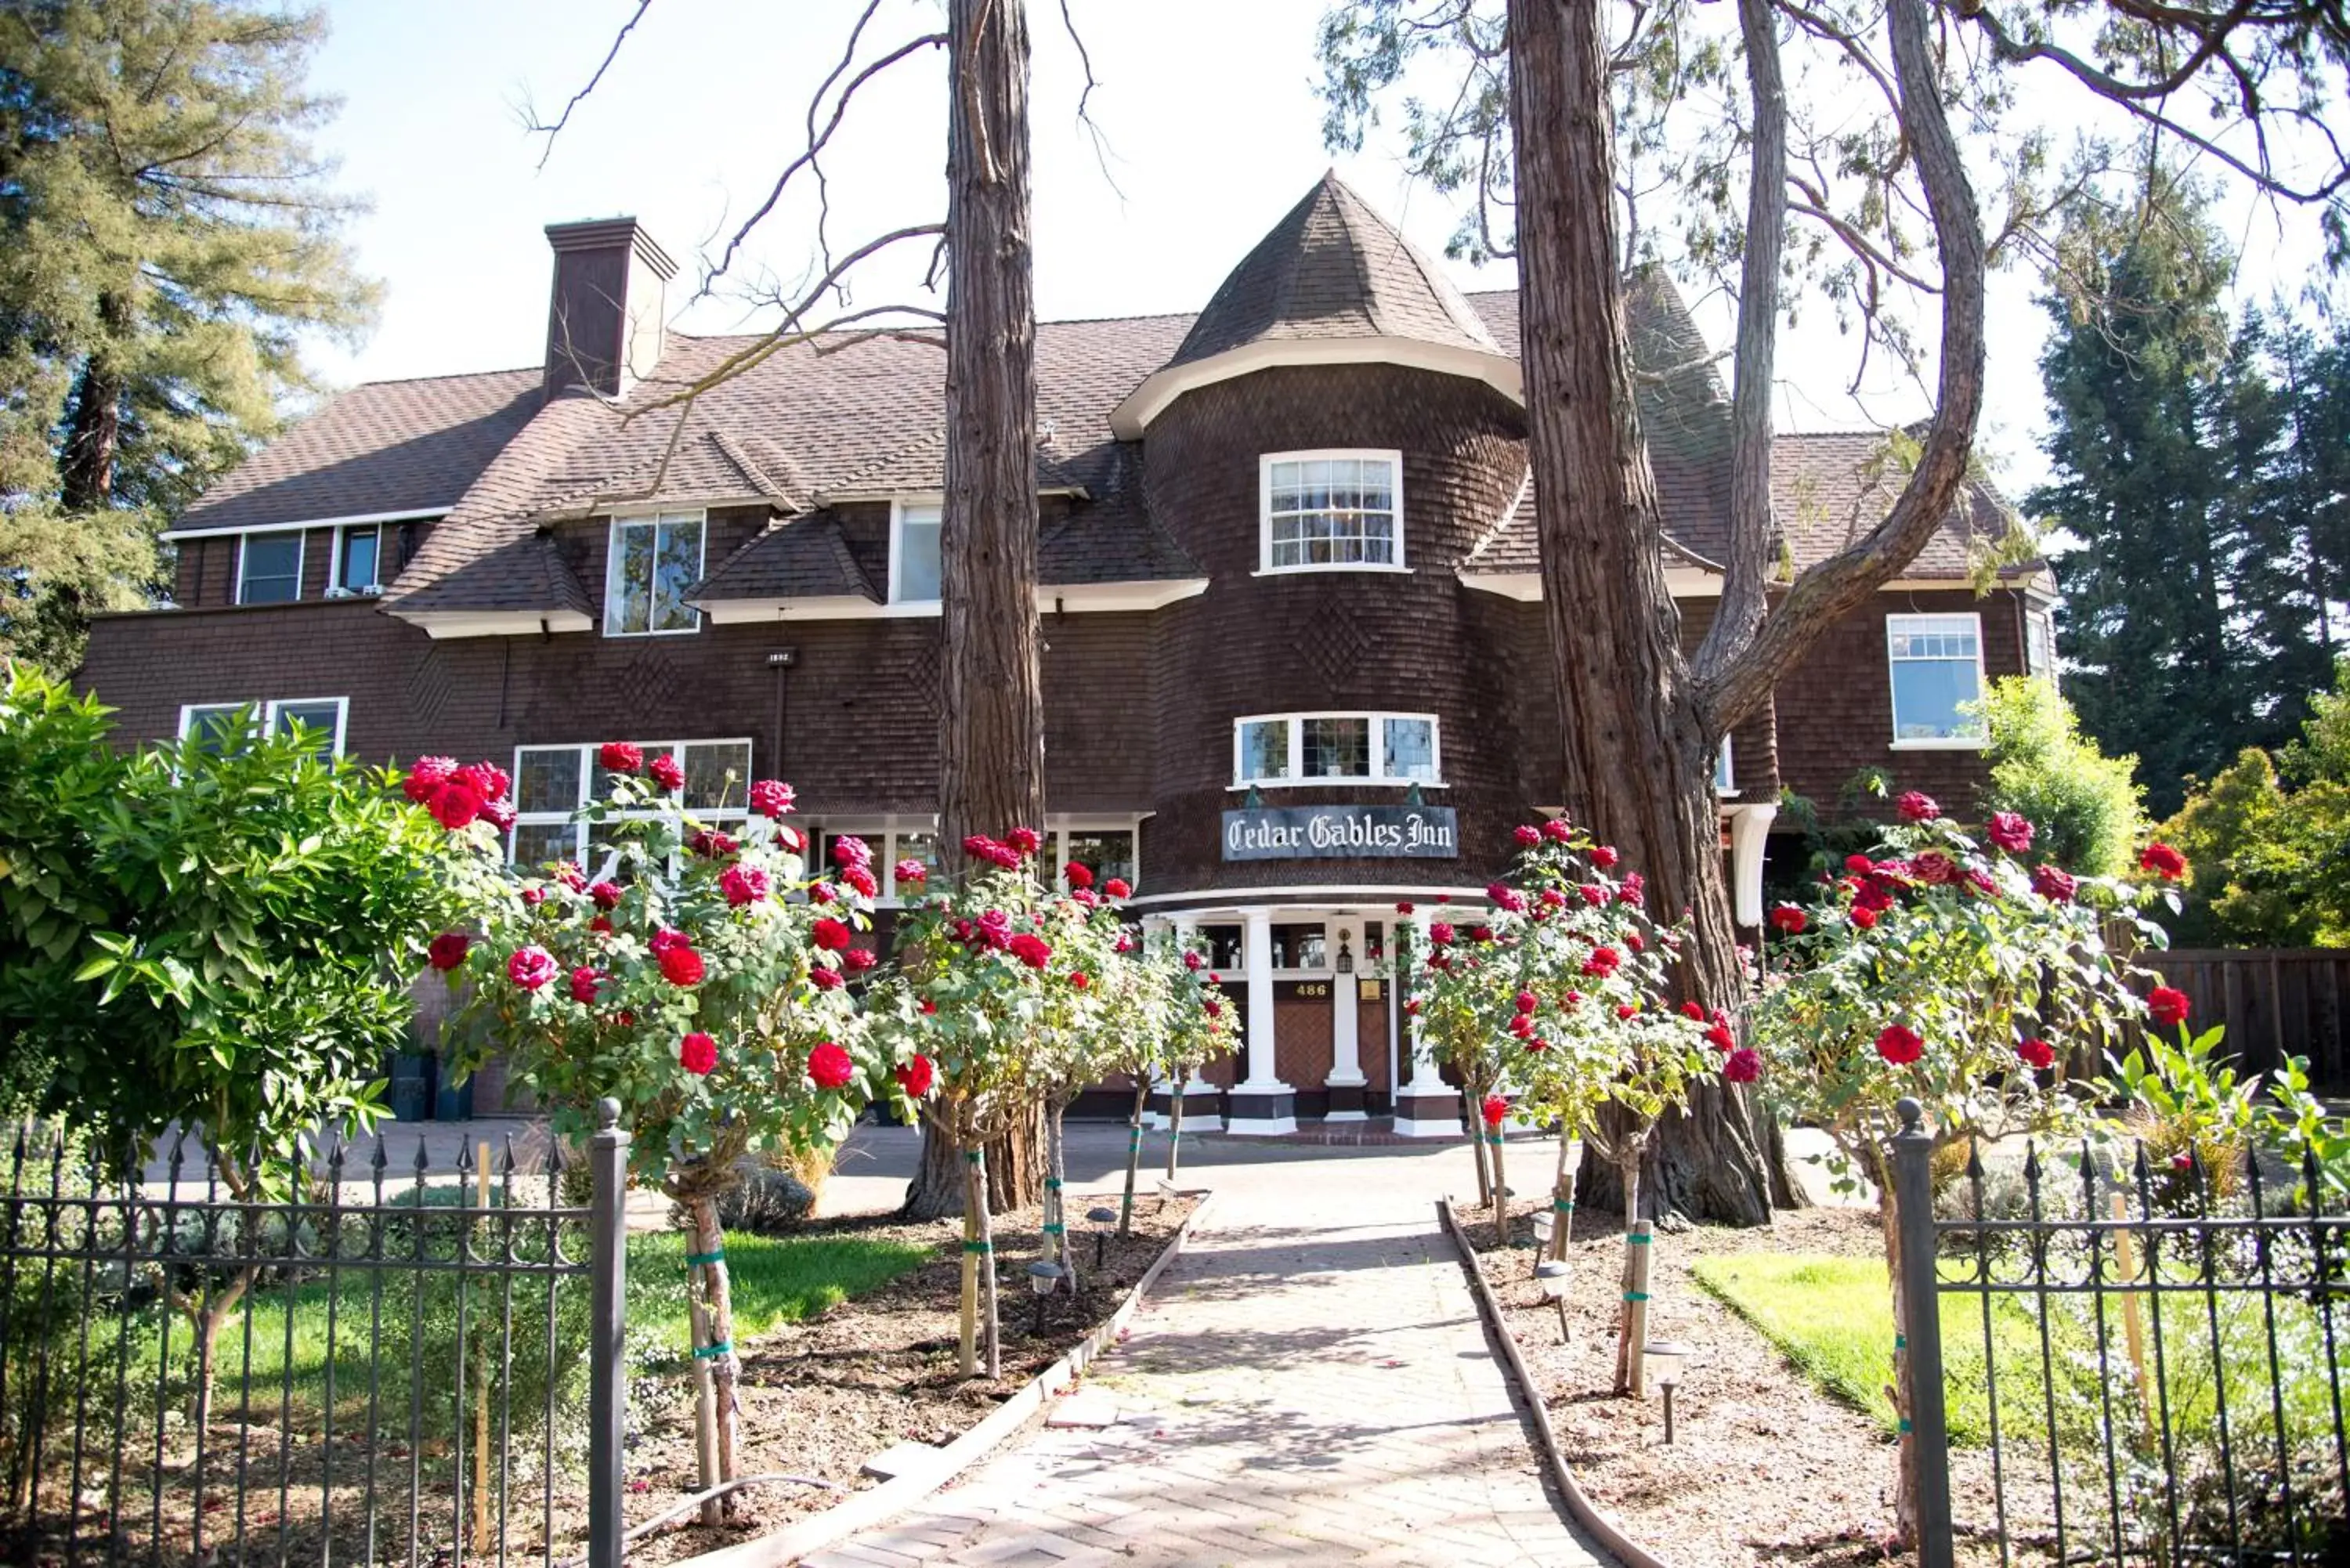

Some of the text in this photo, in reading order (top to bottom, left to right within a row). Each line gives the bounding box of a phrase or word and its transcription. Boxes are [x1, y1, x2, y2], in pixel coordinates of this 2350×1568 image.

[1227, 814, 1452, 852] Cedar Gables Inn
[1296, 984, 1327, 996] 486
